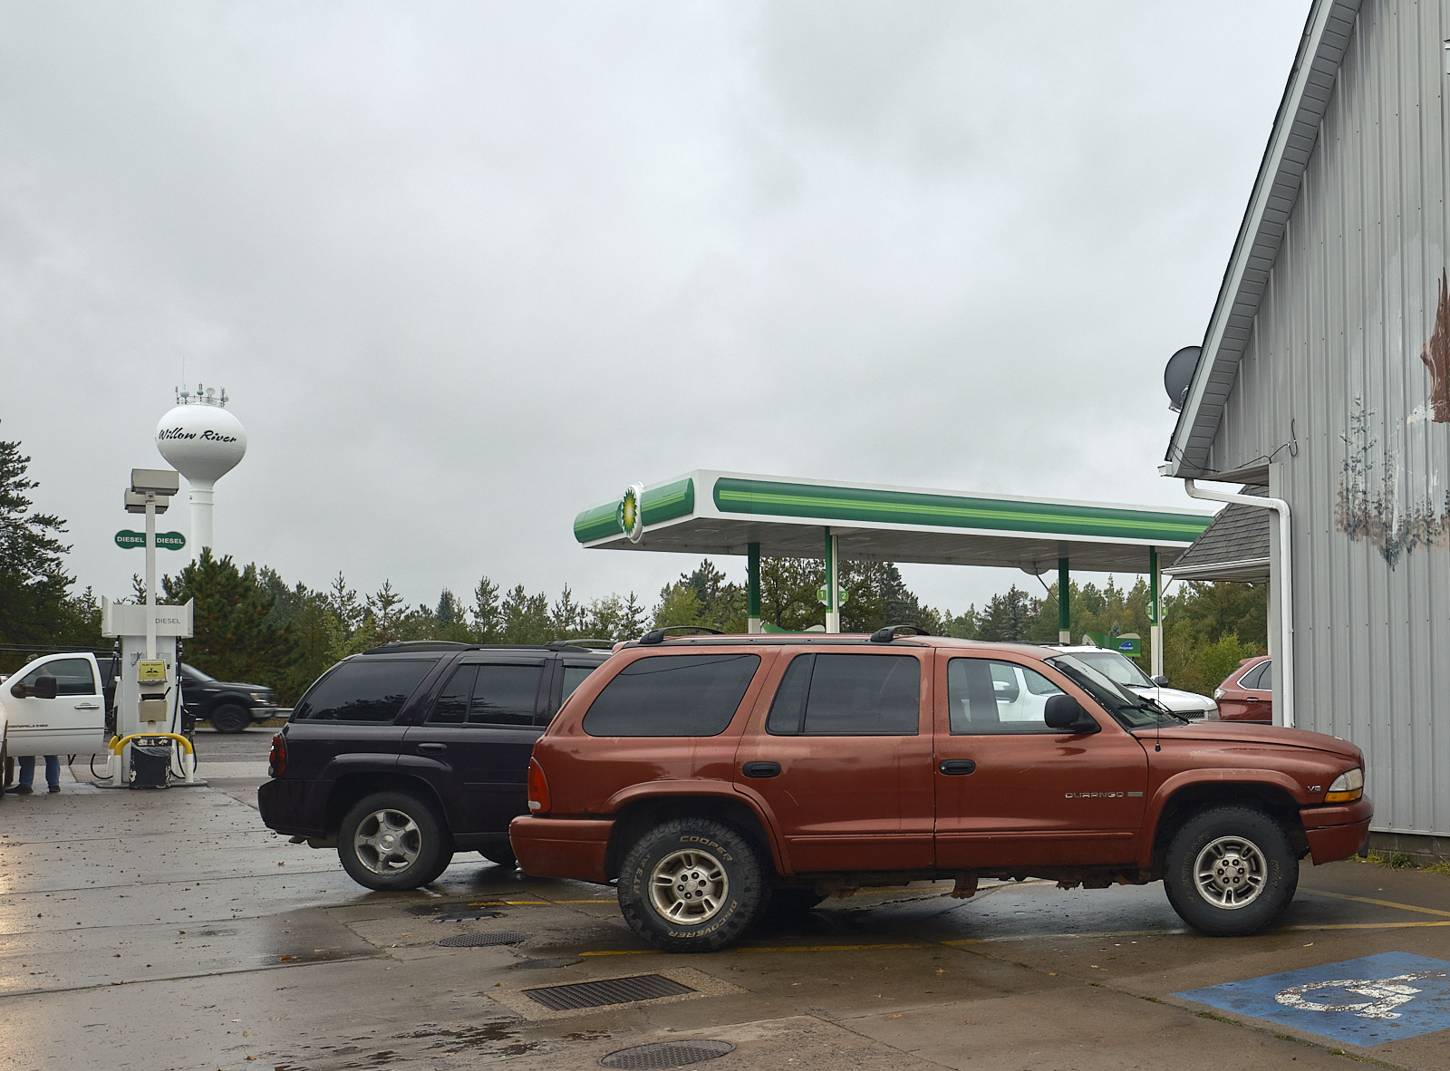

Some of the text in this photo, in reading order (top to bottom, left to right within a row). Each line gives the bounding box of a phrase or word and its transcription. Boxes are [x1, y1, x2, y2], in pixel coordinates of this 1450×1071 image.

[158, 427, 237, 442] Willow River
[155, 617, 182, 625] DIESEL
[1065, 791, 1125, 799] DURANGO
[679, 835, 734, 862] COOPER
[667, 899, 738, 938] DISCOVERER
